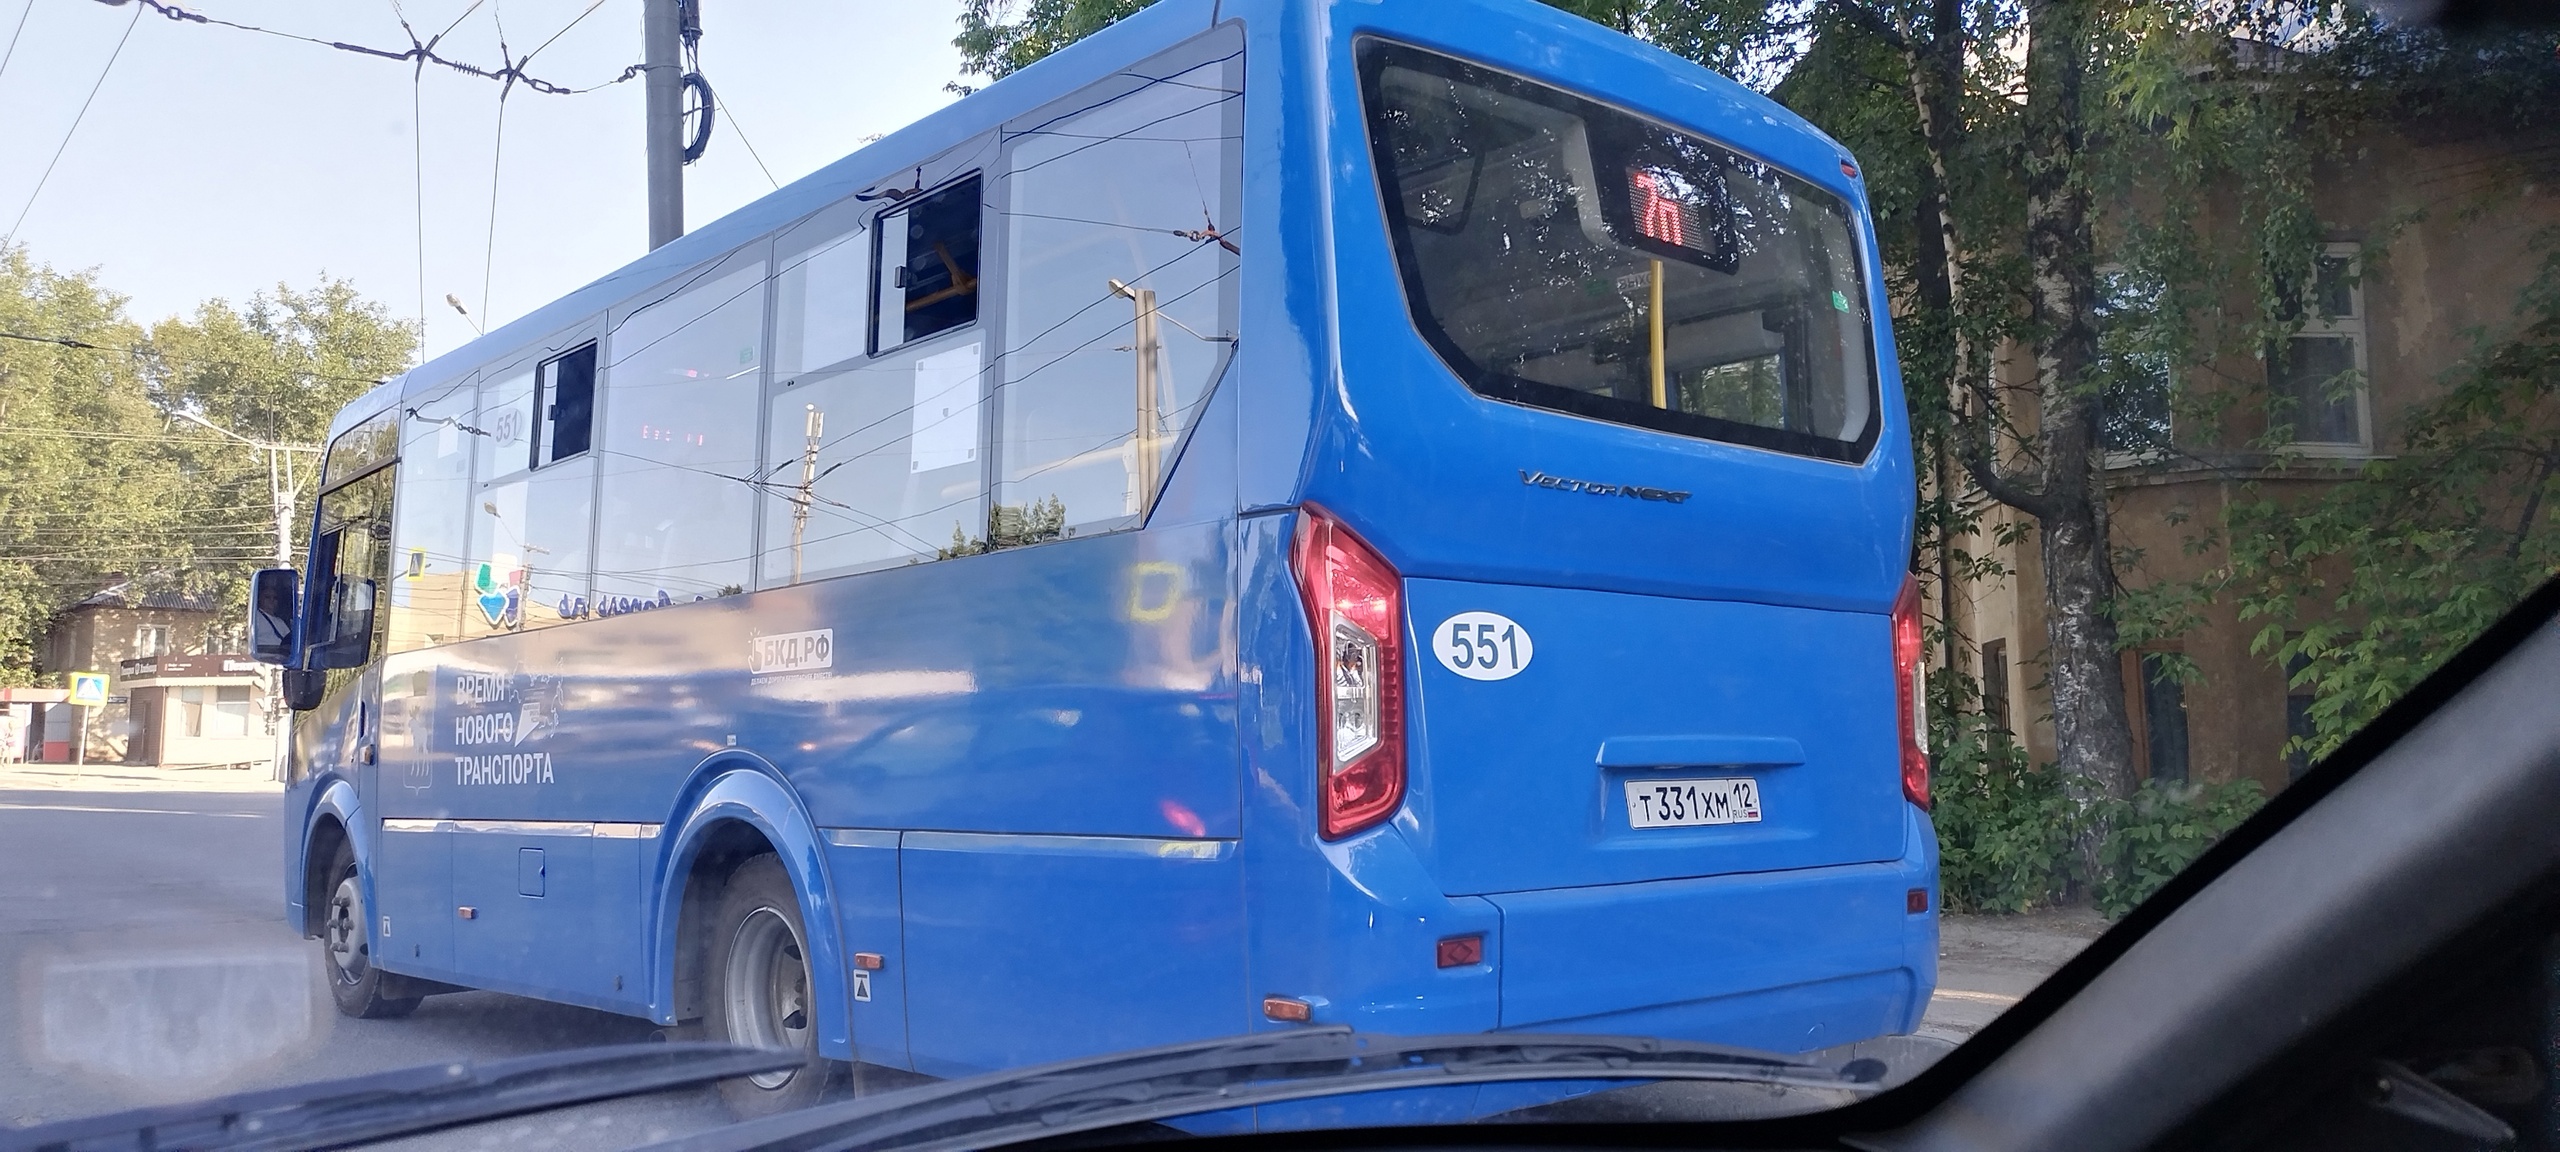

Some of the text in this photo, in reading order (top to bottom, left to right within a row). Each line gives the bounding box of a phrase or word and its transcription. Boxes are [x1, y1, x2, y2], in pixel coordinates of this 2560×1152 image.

[496, 410, 518, 442] 551
[764, 634, 830, 668] БКД.РФ
[1452, 623, 1519, 669] 551
[456, 672, 505, 705] ВРЕМЯ
[455, 711, 514, 745] НОВОГО
[454, 752, 555, 785] ТРАНСПОРТА
[1733, 783, 1753, 808] 12
[1732, 809, 1748, 819] RUS
